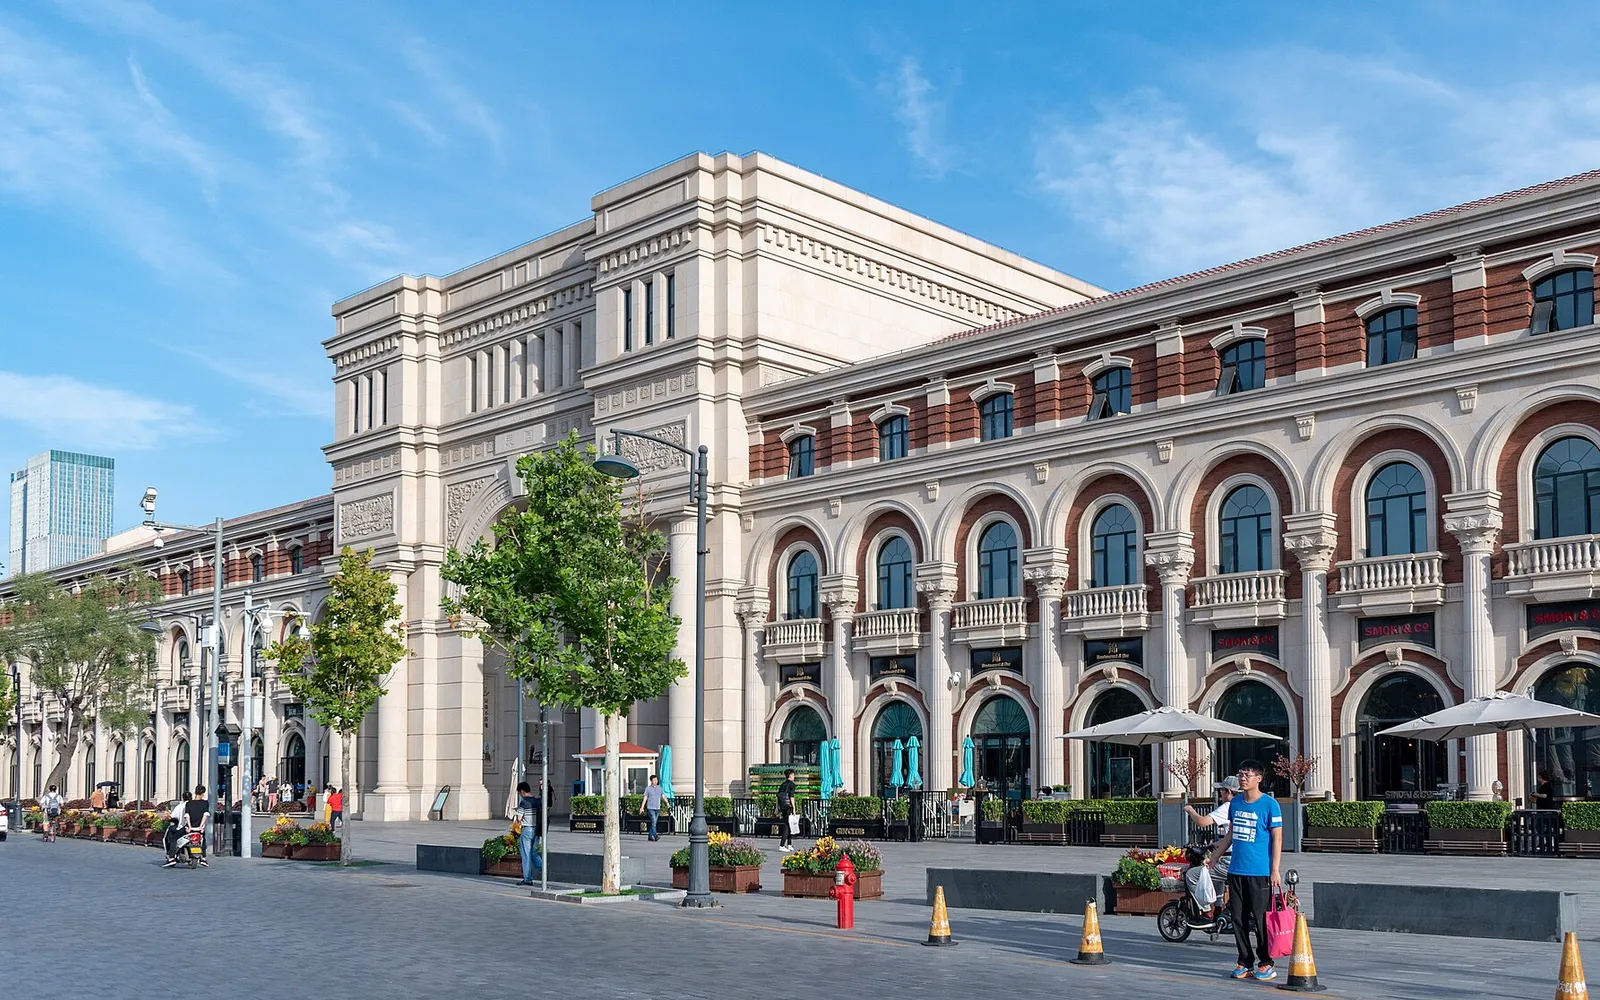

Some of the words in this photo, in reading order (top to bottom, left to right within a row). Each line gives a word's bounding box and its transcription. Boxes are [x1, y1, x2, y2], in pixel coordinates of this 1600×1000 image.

[1535, 612, 1577, 624] SMOKI
[1578, 608, 1589, 621] &
[1365, 625, 1402, 636] SMOKI
[1403, 623, 1412, 634] &
[1218, 638, 1250, 648] SMOKI
[1251, 635, 1258, 645] &
